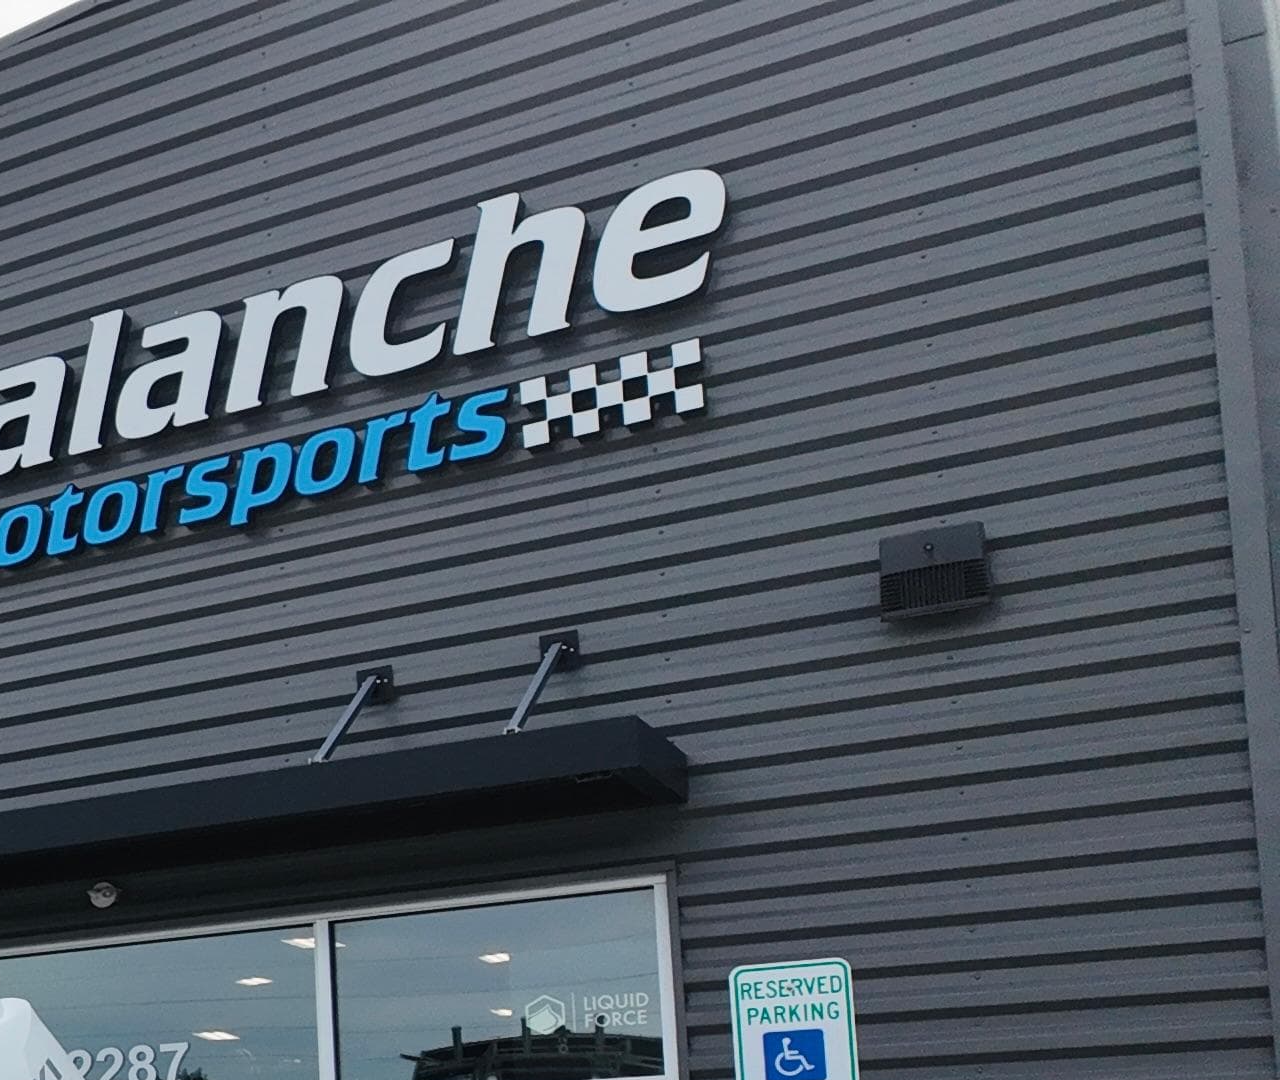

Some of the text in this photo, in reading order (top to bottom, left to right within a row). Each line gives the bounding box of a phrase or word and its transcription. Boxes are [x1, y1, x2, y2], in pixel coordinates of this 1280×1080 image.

[740, 975, 843, 1001] RESERVED
[583, 992, 649, 1012] LIQUID
[747, 1001, 840, 1025] PARKING
[584, 1009, 648, 1028] FORCE
